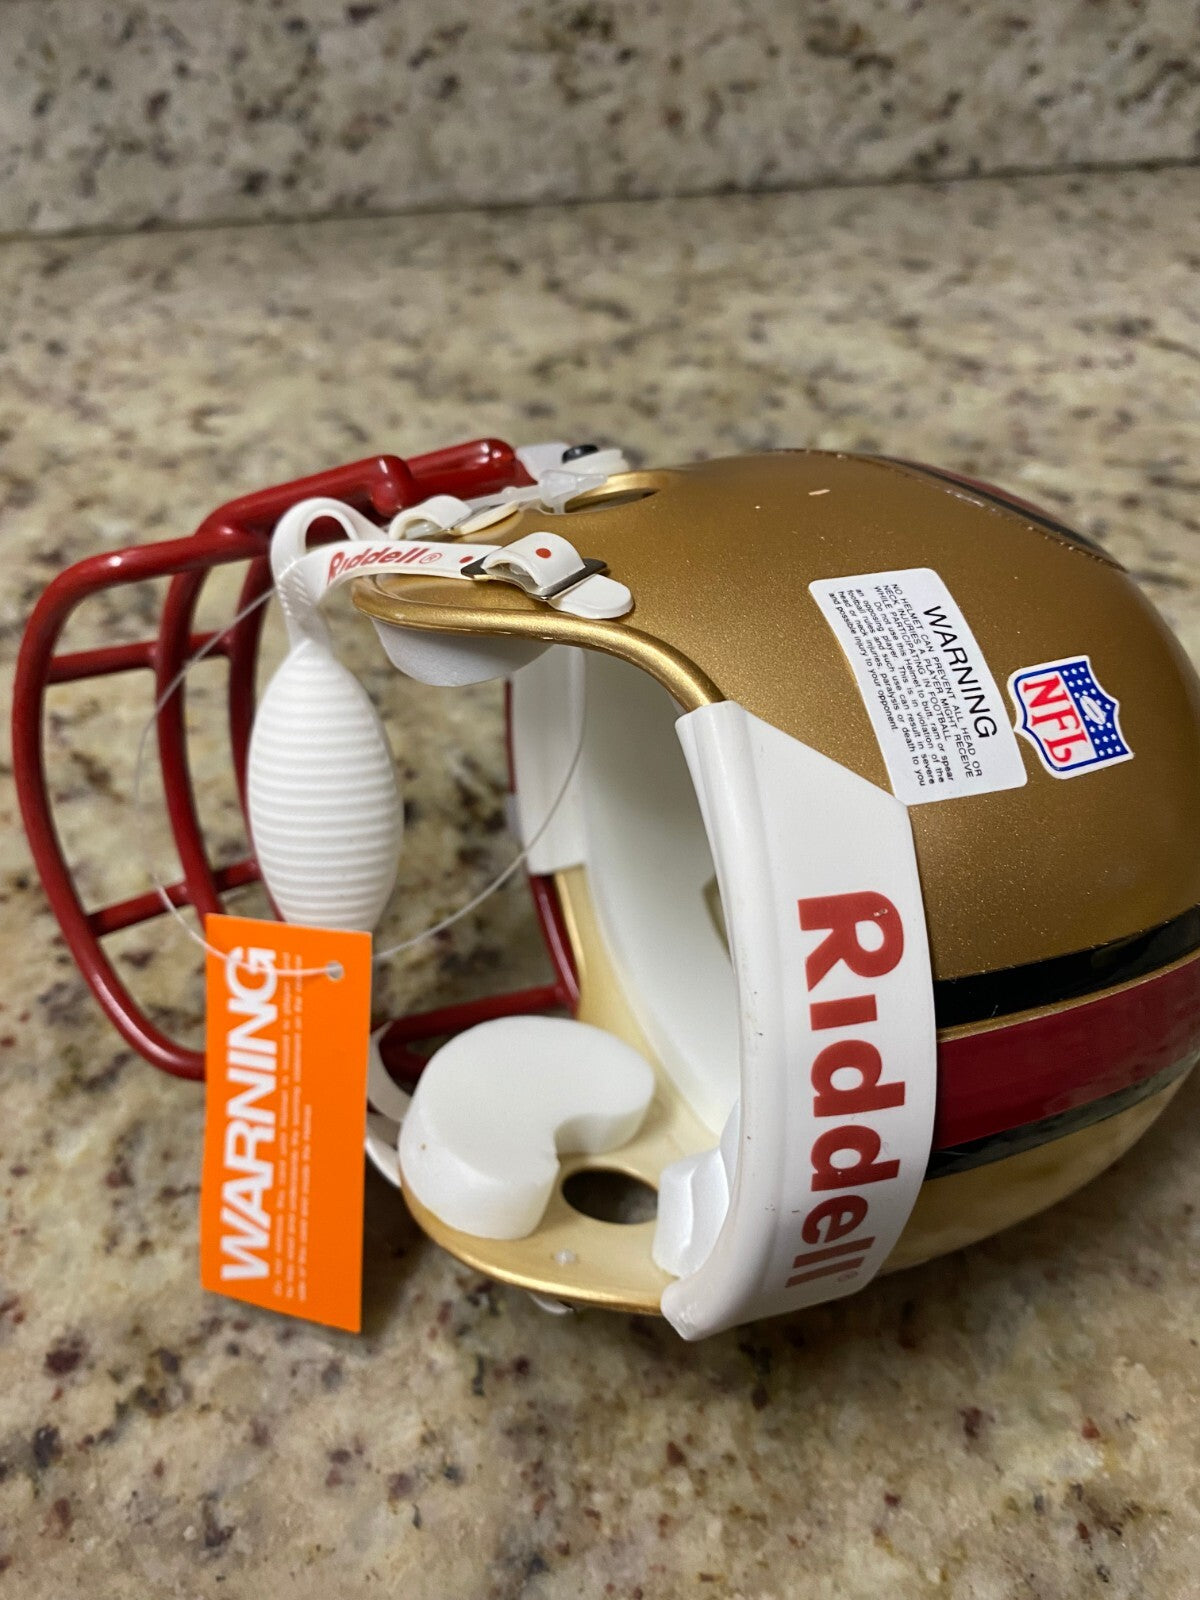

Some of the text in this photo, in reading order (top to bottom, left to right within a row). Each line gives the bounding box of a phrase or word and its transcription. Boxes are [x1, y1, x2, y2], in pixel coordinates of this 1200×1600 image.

[874, 585, 952, 741] WHILE PARTICIPATING IN FOOTBALL
[882, 584, 900, 605] NECK
[898, 608, 922, 645] INJURIES
[924, 658, 944, 695] PLAYER
[940, 698, 959, 729] MIGHT
[954, 733, 974, 778] RECEIVE
[891, 583, 983, 777] NO HELMET CAN PREVENT ALL HEAD OR
[923, 605, 998, 738] WARNING
[897, 714, 905, 723] or
[912, 756, 919, 765] to
[911, 699, 919, 708] in
[931, 754, 940, 763] of
[917, 741, 924, 750] in
[937, 743, 945, 752] or
[1023, 675, 1088, 762] NFL
[220, 946, 278, 1281] WARNING
